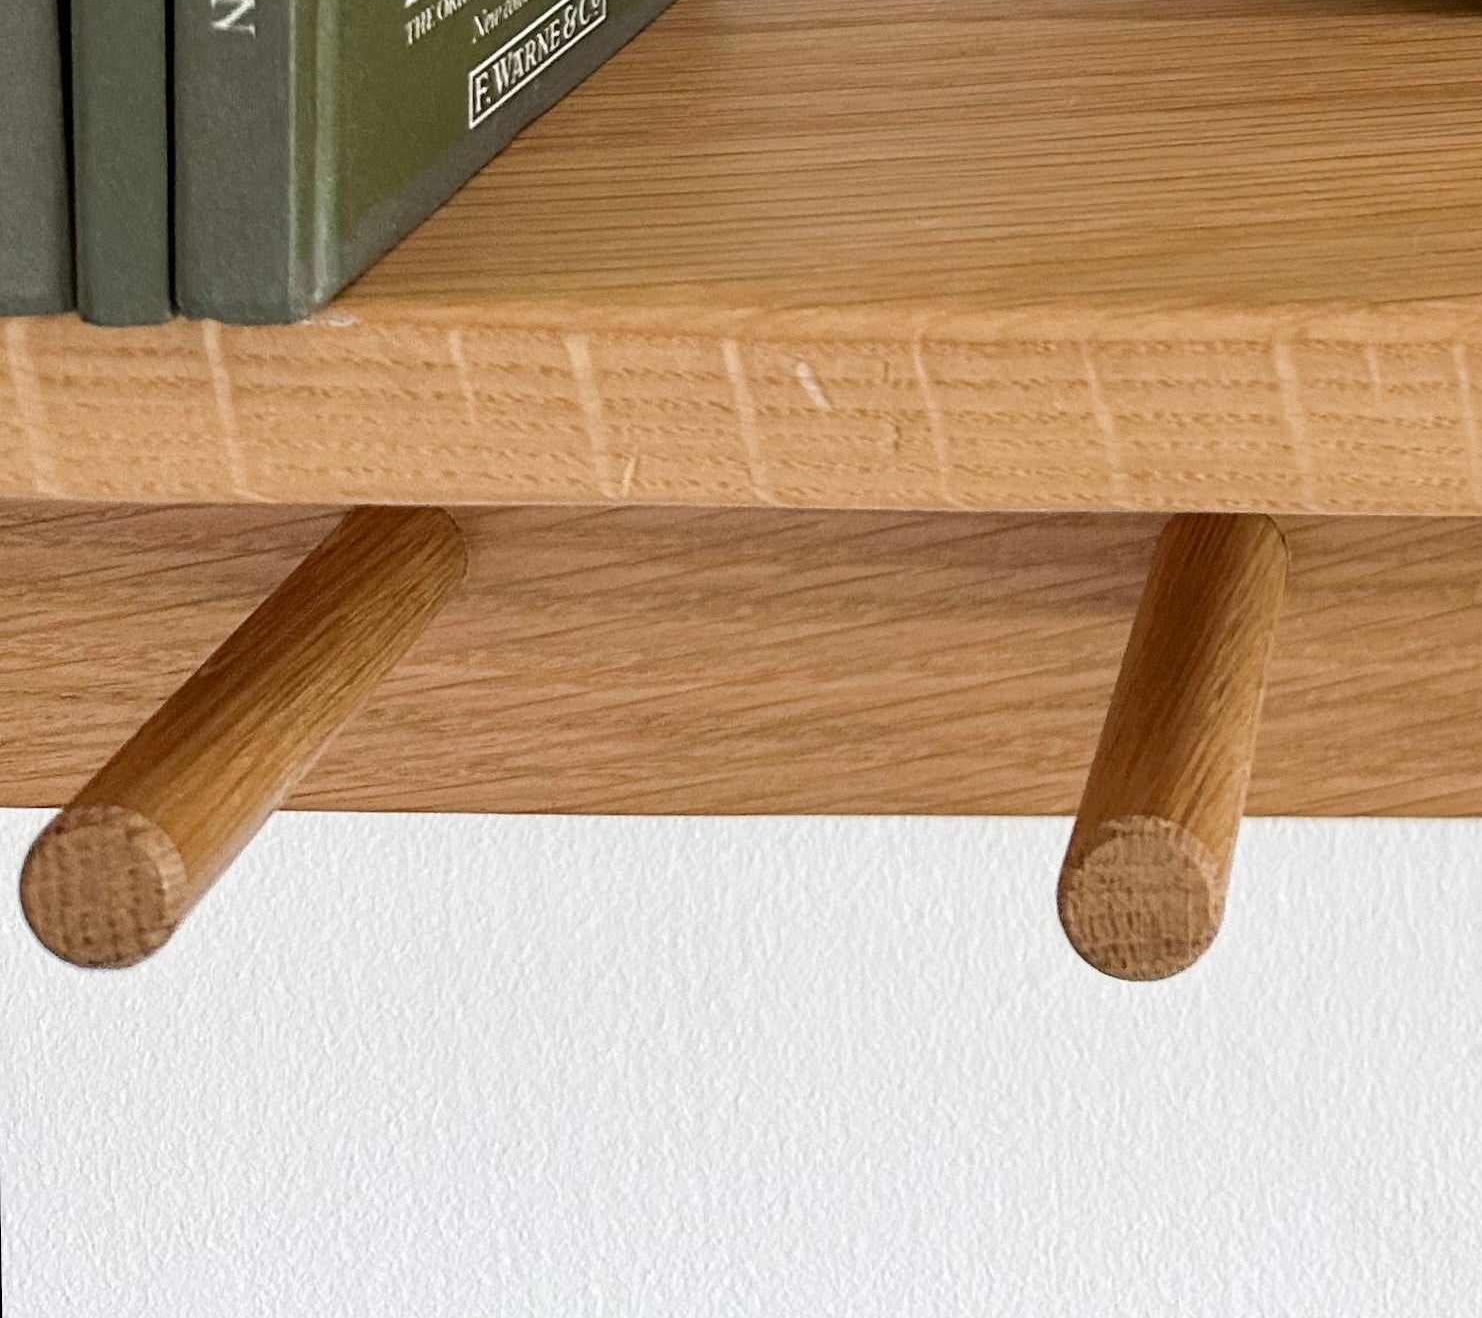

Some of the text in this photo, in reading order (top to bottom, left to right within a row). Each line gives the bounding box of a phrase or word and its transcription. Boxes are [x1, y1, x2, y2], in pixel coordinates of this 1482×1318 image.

[405, 3, 436, 46] THE
[472, 6, 503, 44] New
[493, 19, 560, 95] WARNE
